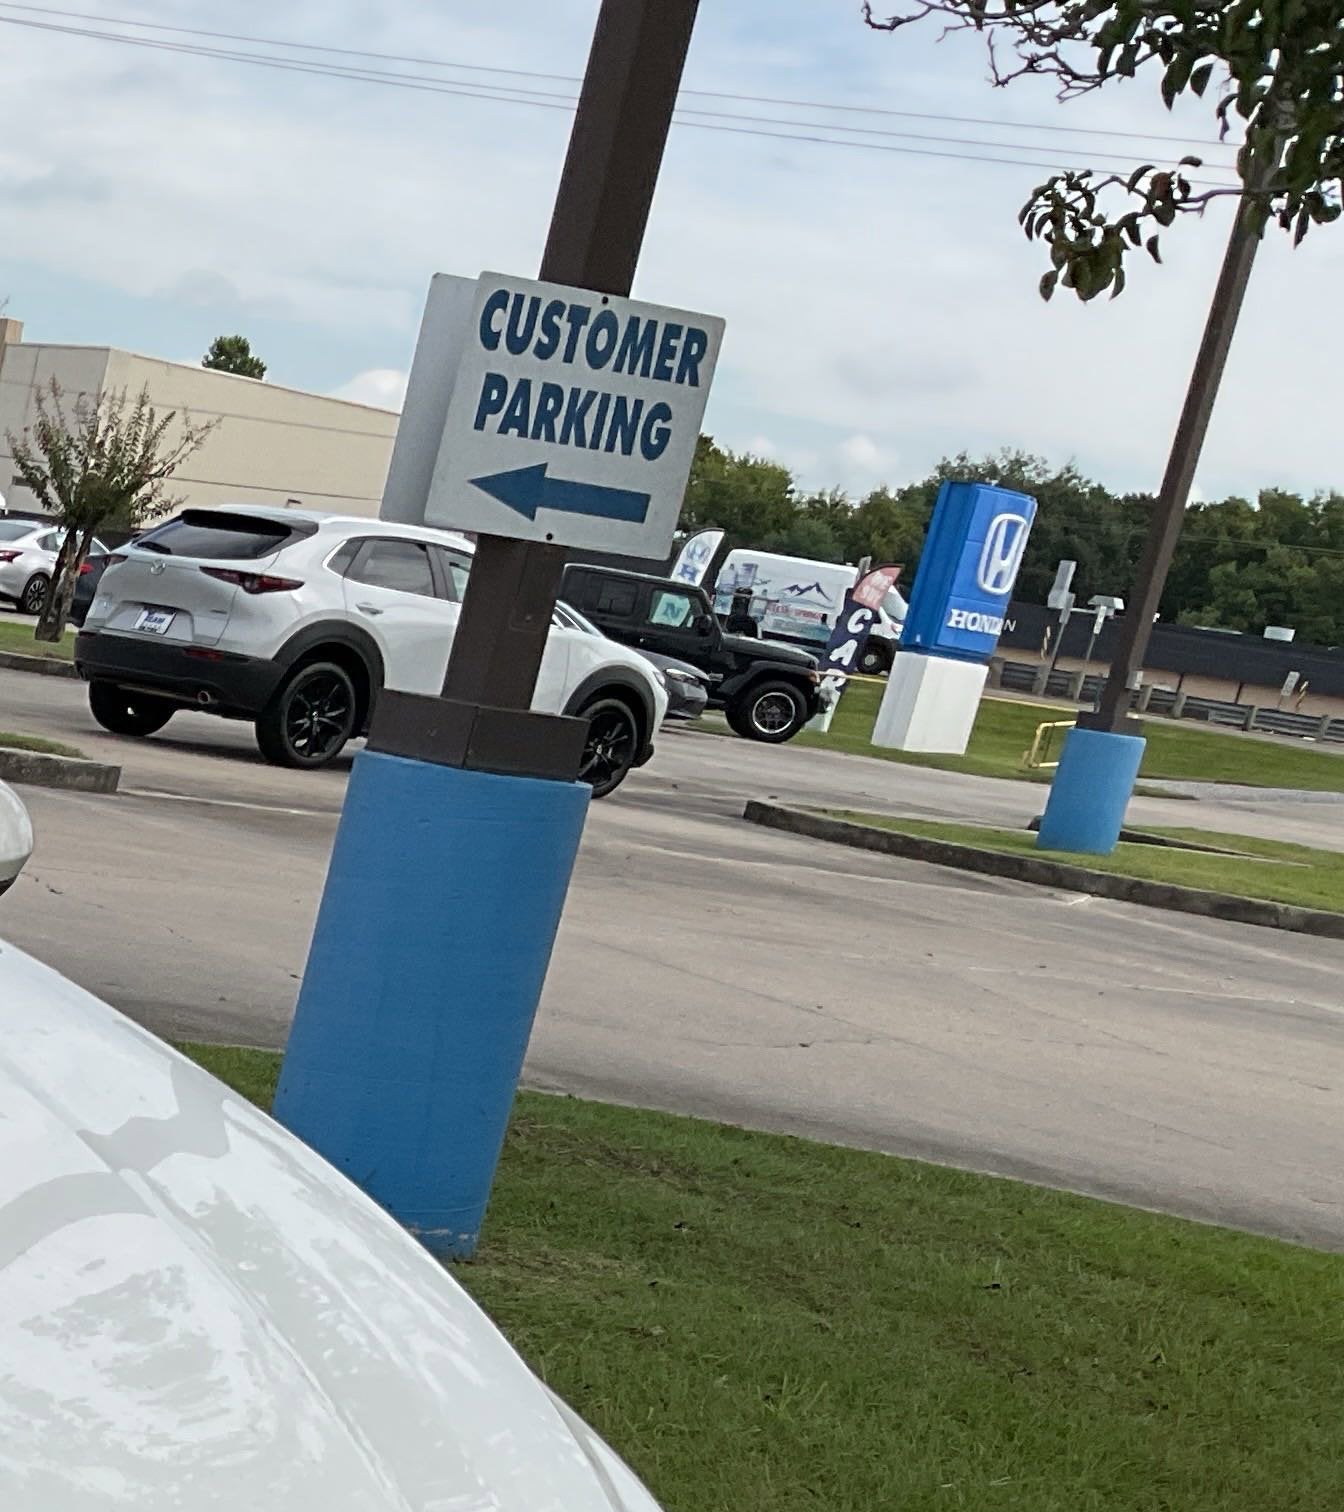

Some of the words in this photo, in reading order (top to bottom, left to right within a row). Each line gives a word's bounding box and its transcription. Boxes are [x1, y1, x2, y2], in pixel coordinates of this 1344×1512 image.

[478, 288, 708, 388] CUSTOMER
[473, 371, 673, 462] PARKING
[946, 608, 1004, 636] HOND
